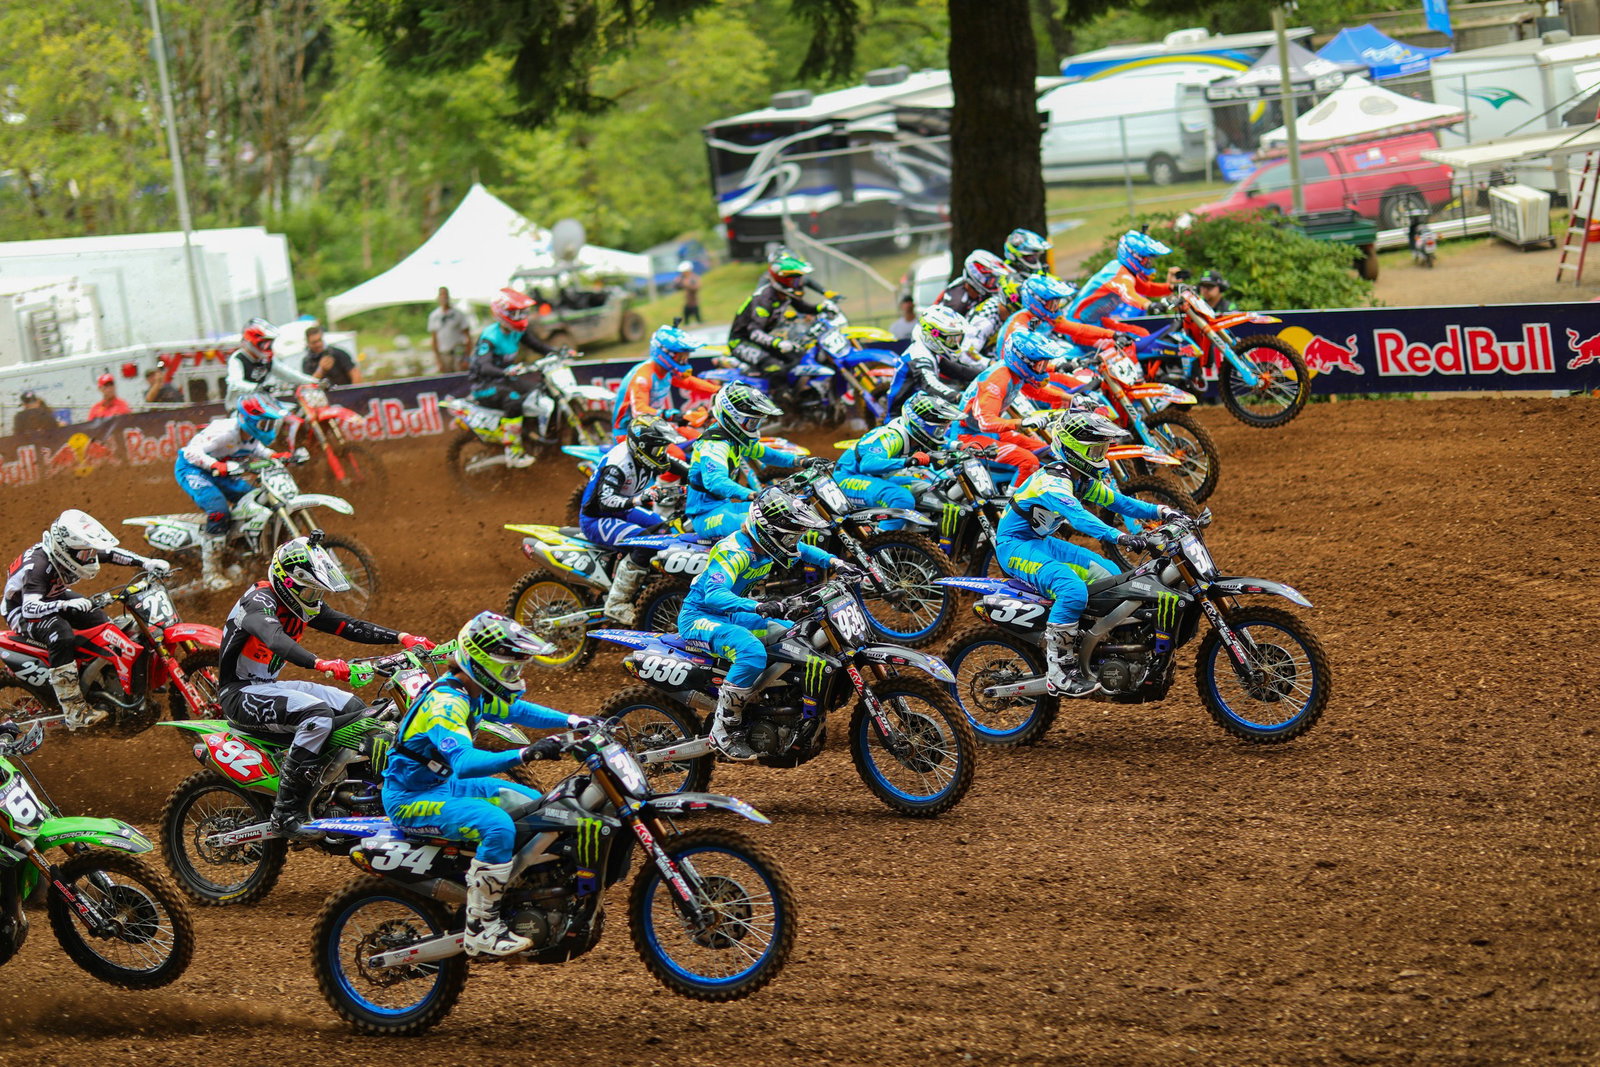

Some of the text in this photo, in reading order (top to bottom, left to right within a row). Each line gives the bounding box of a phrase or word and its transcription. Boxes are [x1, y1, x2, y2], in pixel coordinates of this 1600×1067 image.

[563, 551, 591, 571] 26
[664, 551, 708, 575] 66
[143, 590, 174, 621] 23
[990, 600, 1045, 628] 32
[836, 603, 866, 640] 936
[102, 628, 136, 658] GEICO
[14, 661, 50, 687] 23
[639, 656, 693, 686] 936
[216, 740, 263, 777] 92
[59, 831, 98, 842] CIRCUIT
[223, 830, 262, 845] RENTHAL
[318, 822, 370, 832] DUNLOP
[371, 841, 442, 875] 34
